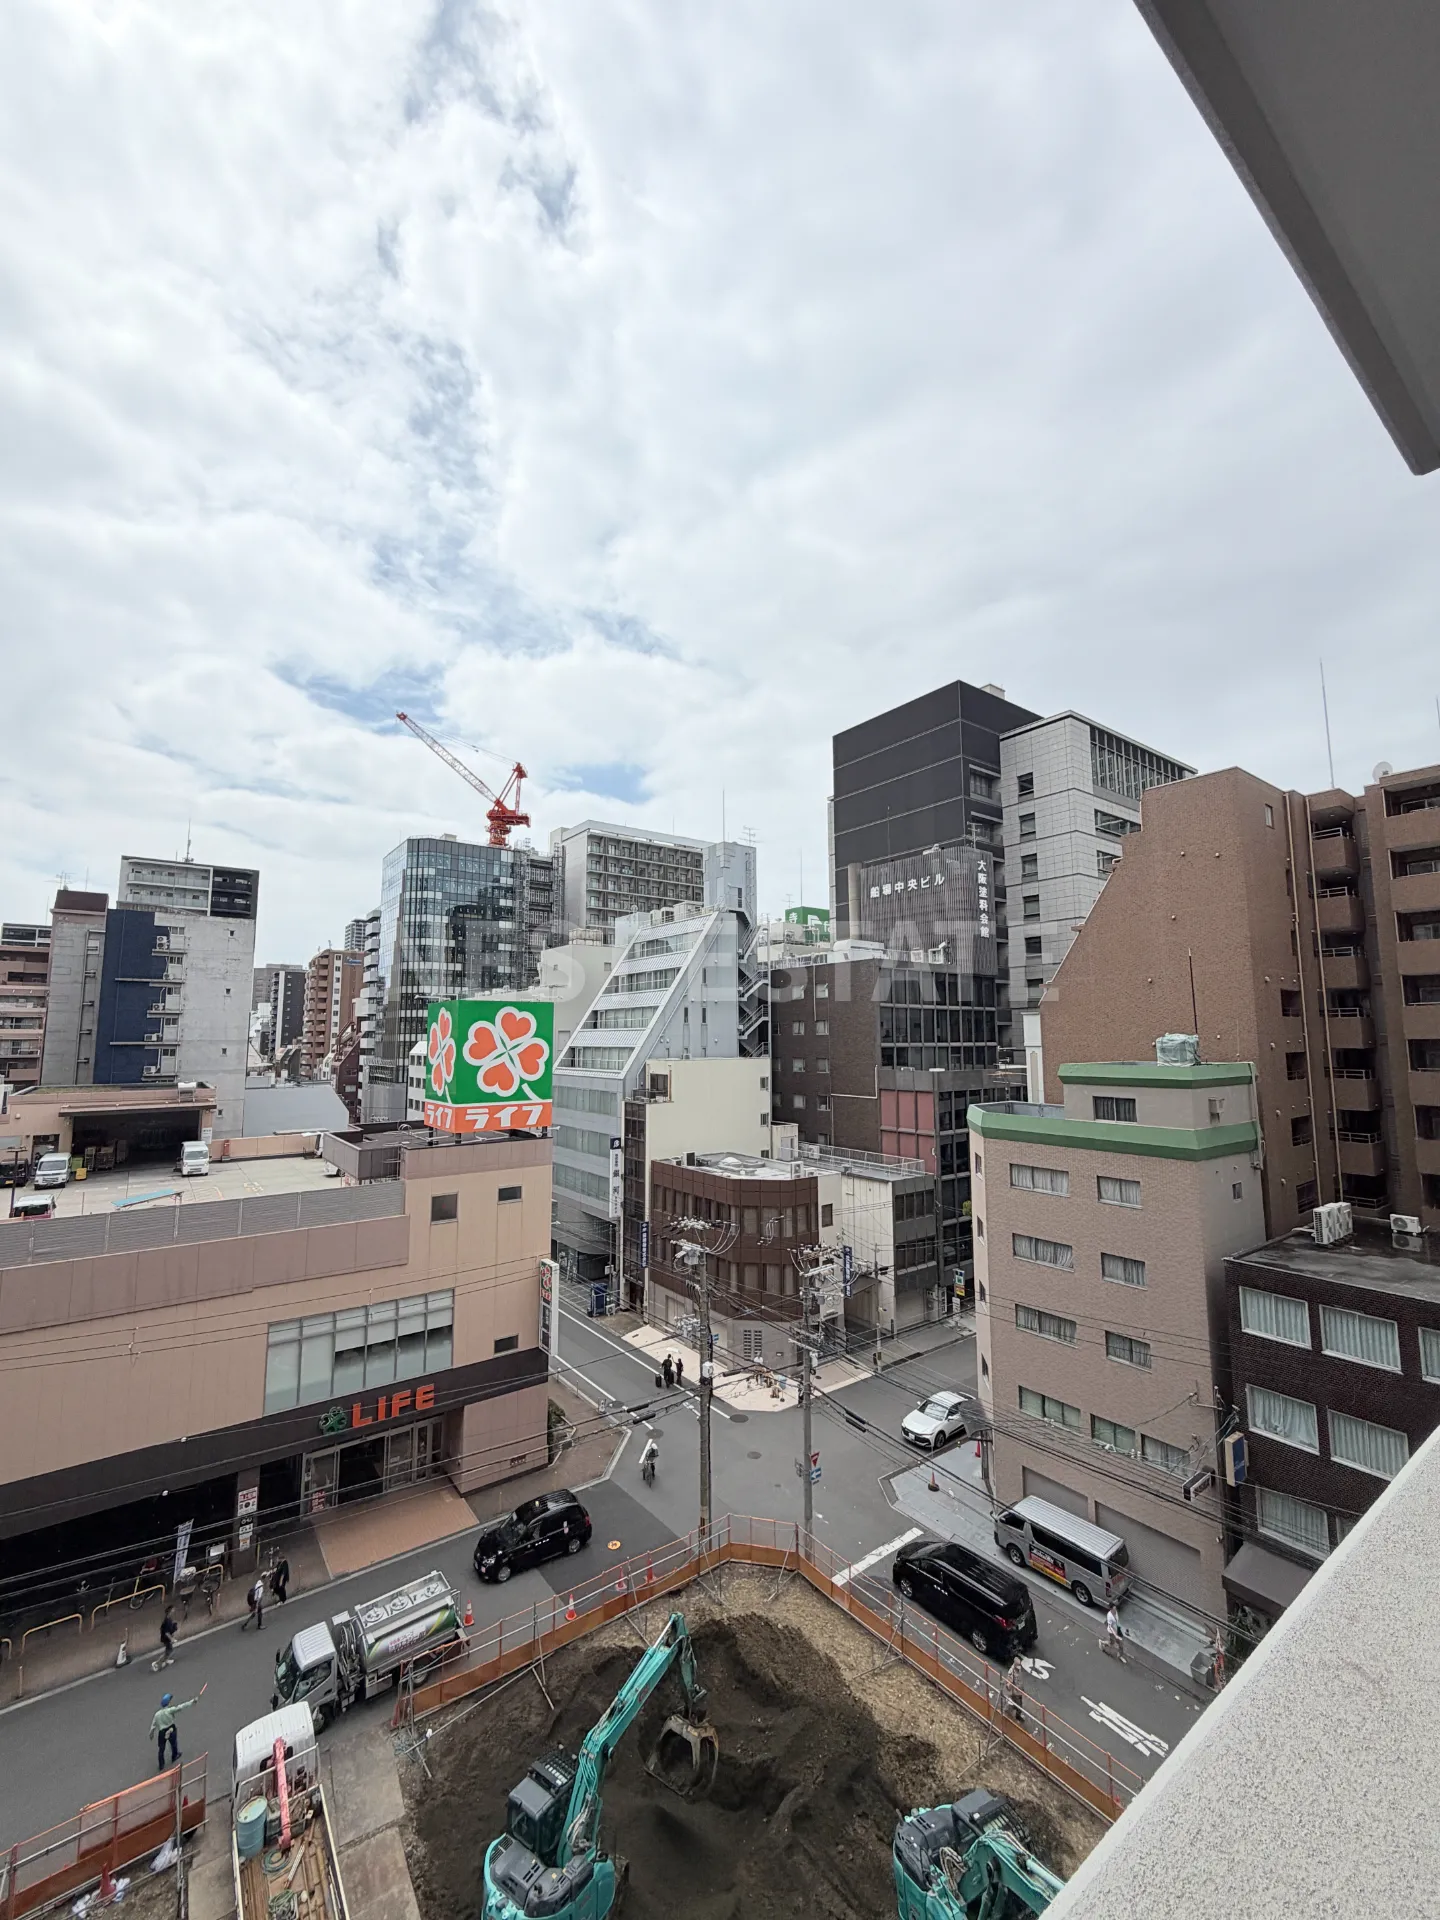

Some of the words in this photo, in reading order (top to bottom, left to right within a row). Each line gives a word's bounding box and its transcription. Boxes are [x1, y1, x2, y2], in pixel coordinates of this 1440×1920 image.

[870, 873, 945, 898] 船場中央ビル
[977, 860, 990, 938] 大阪塗料会館
[427, 1104, 453, 1129] ライフ
[465, 1104, 544, 1129] ライフ
[351, 1383, 435, 1428] LIFE
